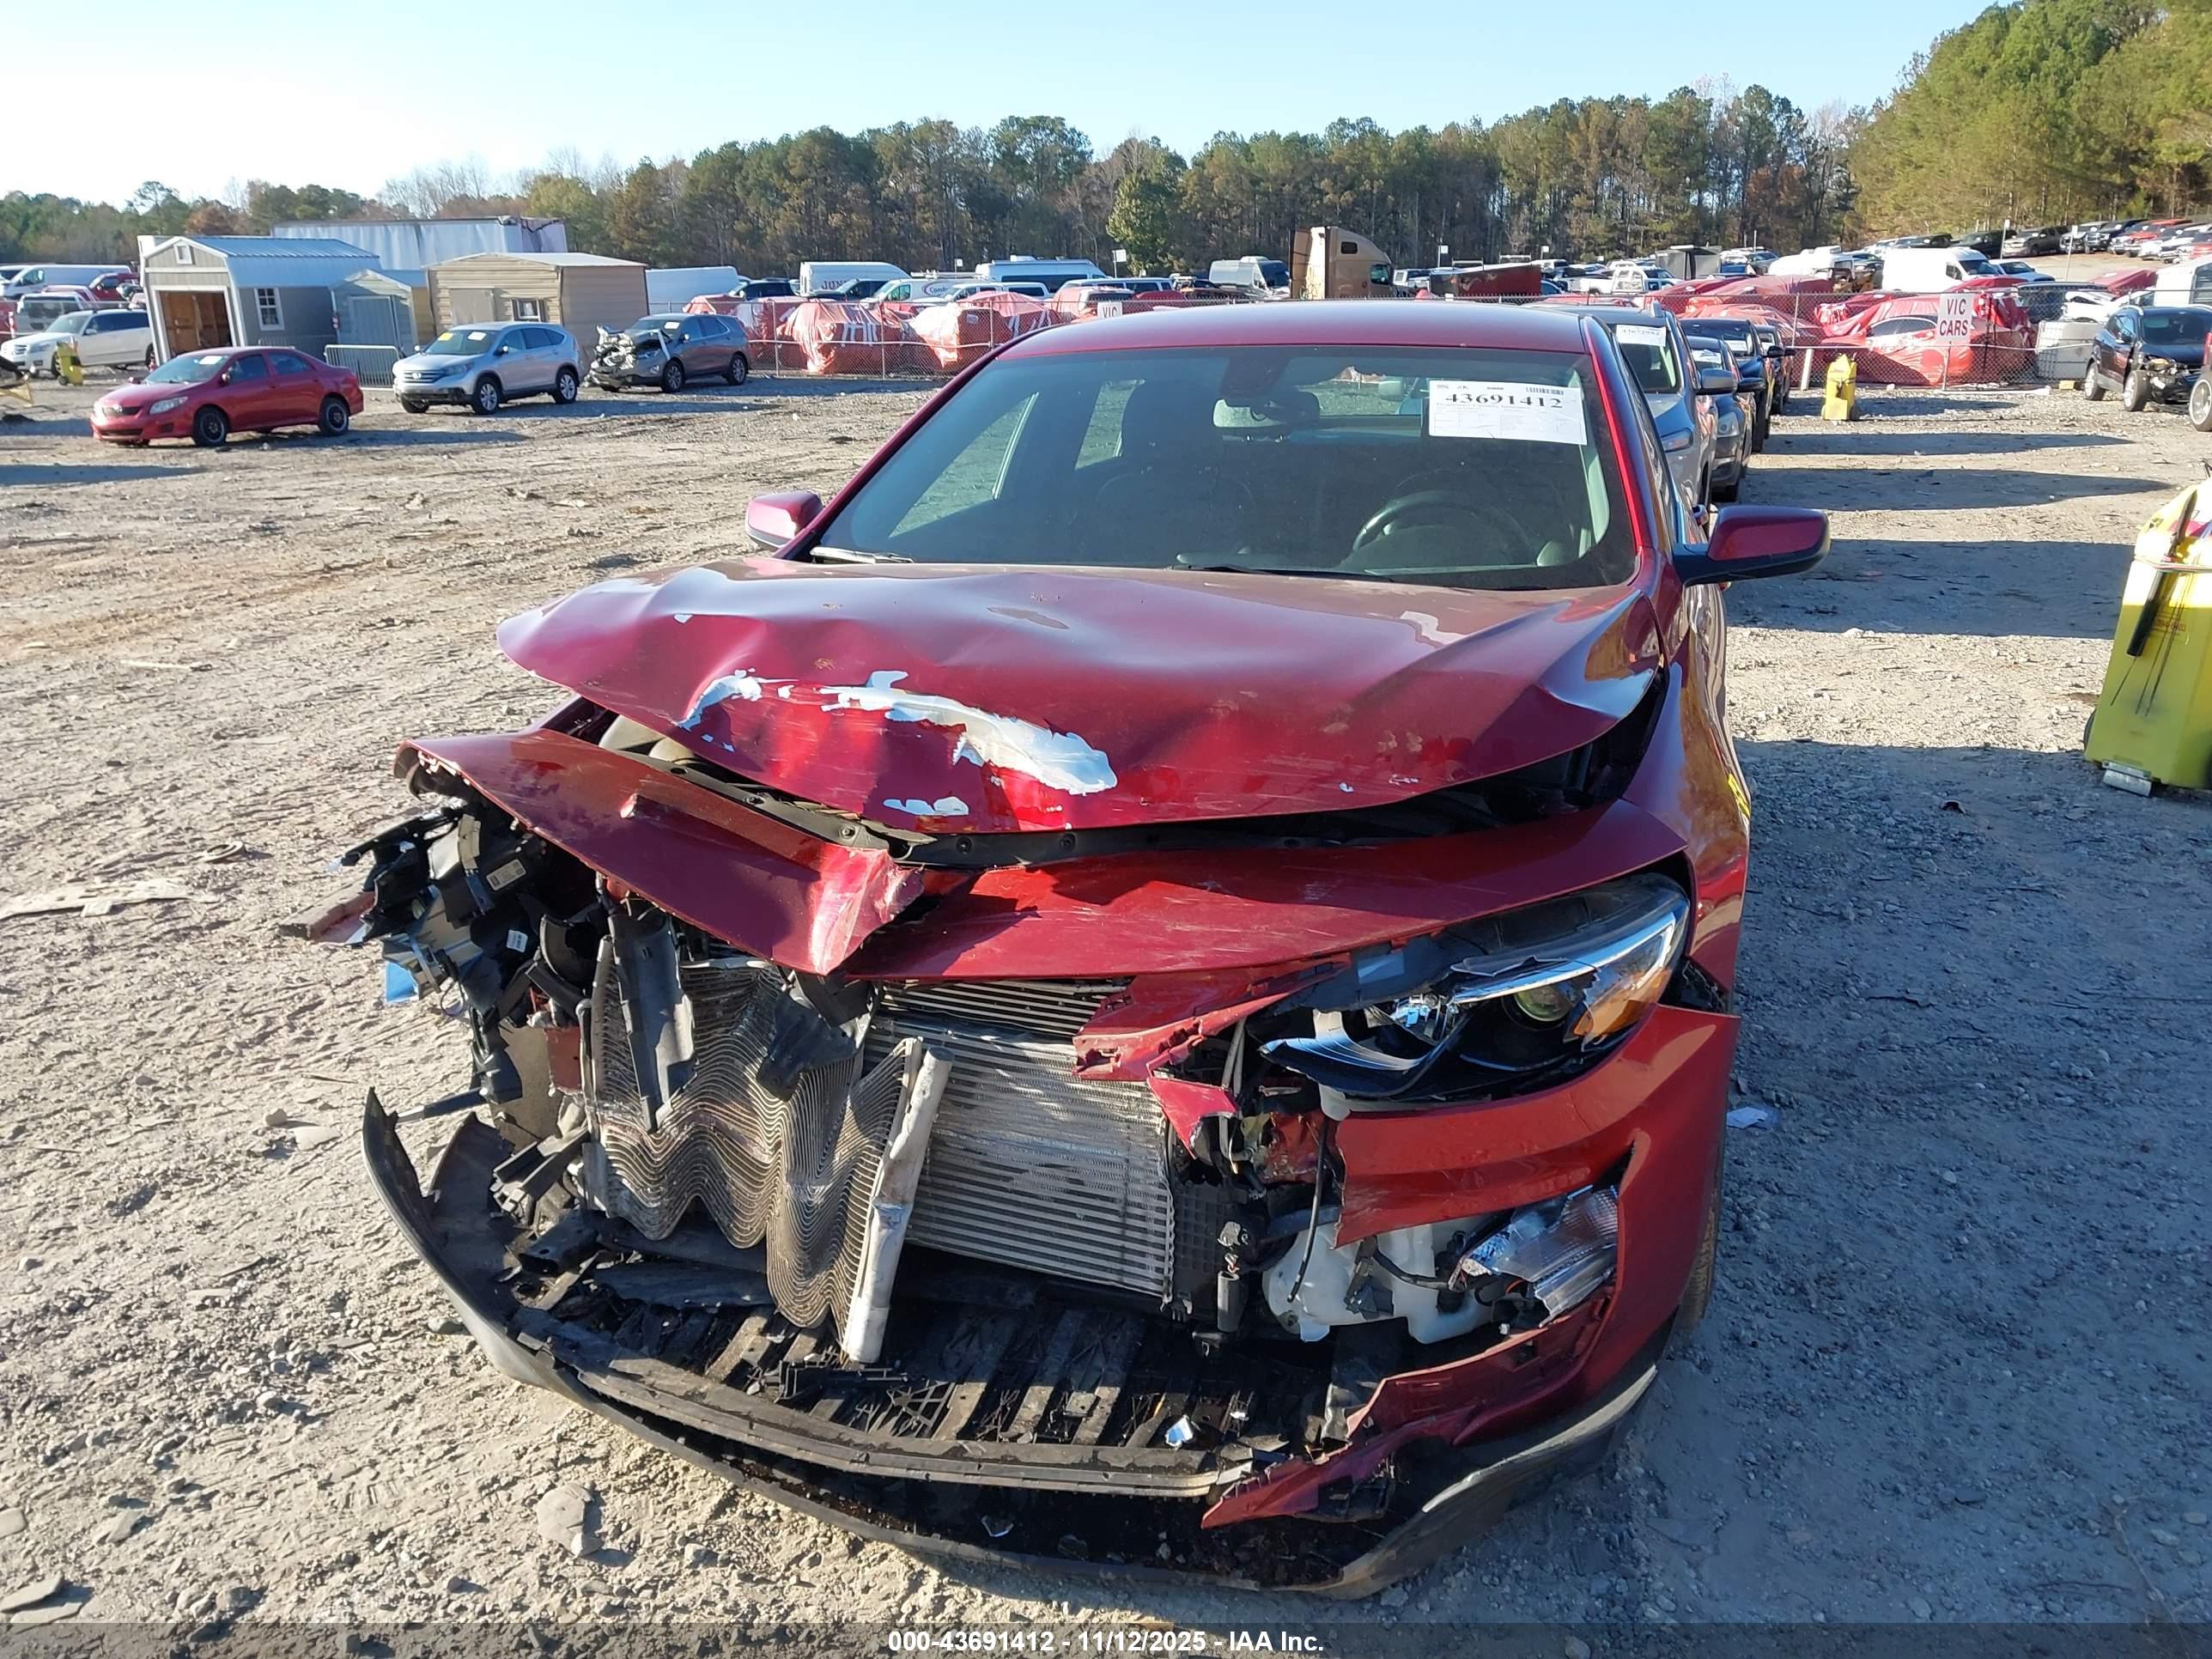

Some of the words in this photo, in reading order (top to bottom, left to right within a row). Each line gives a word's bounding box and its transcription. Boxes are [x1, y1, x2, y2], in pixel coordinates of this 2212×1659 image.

[1947, 298, 1966, 315] VIC
[1939, 319, 1968, 336] CARS
[1445, 393, 1563, 409] 43691412
